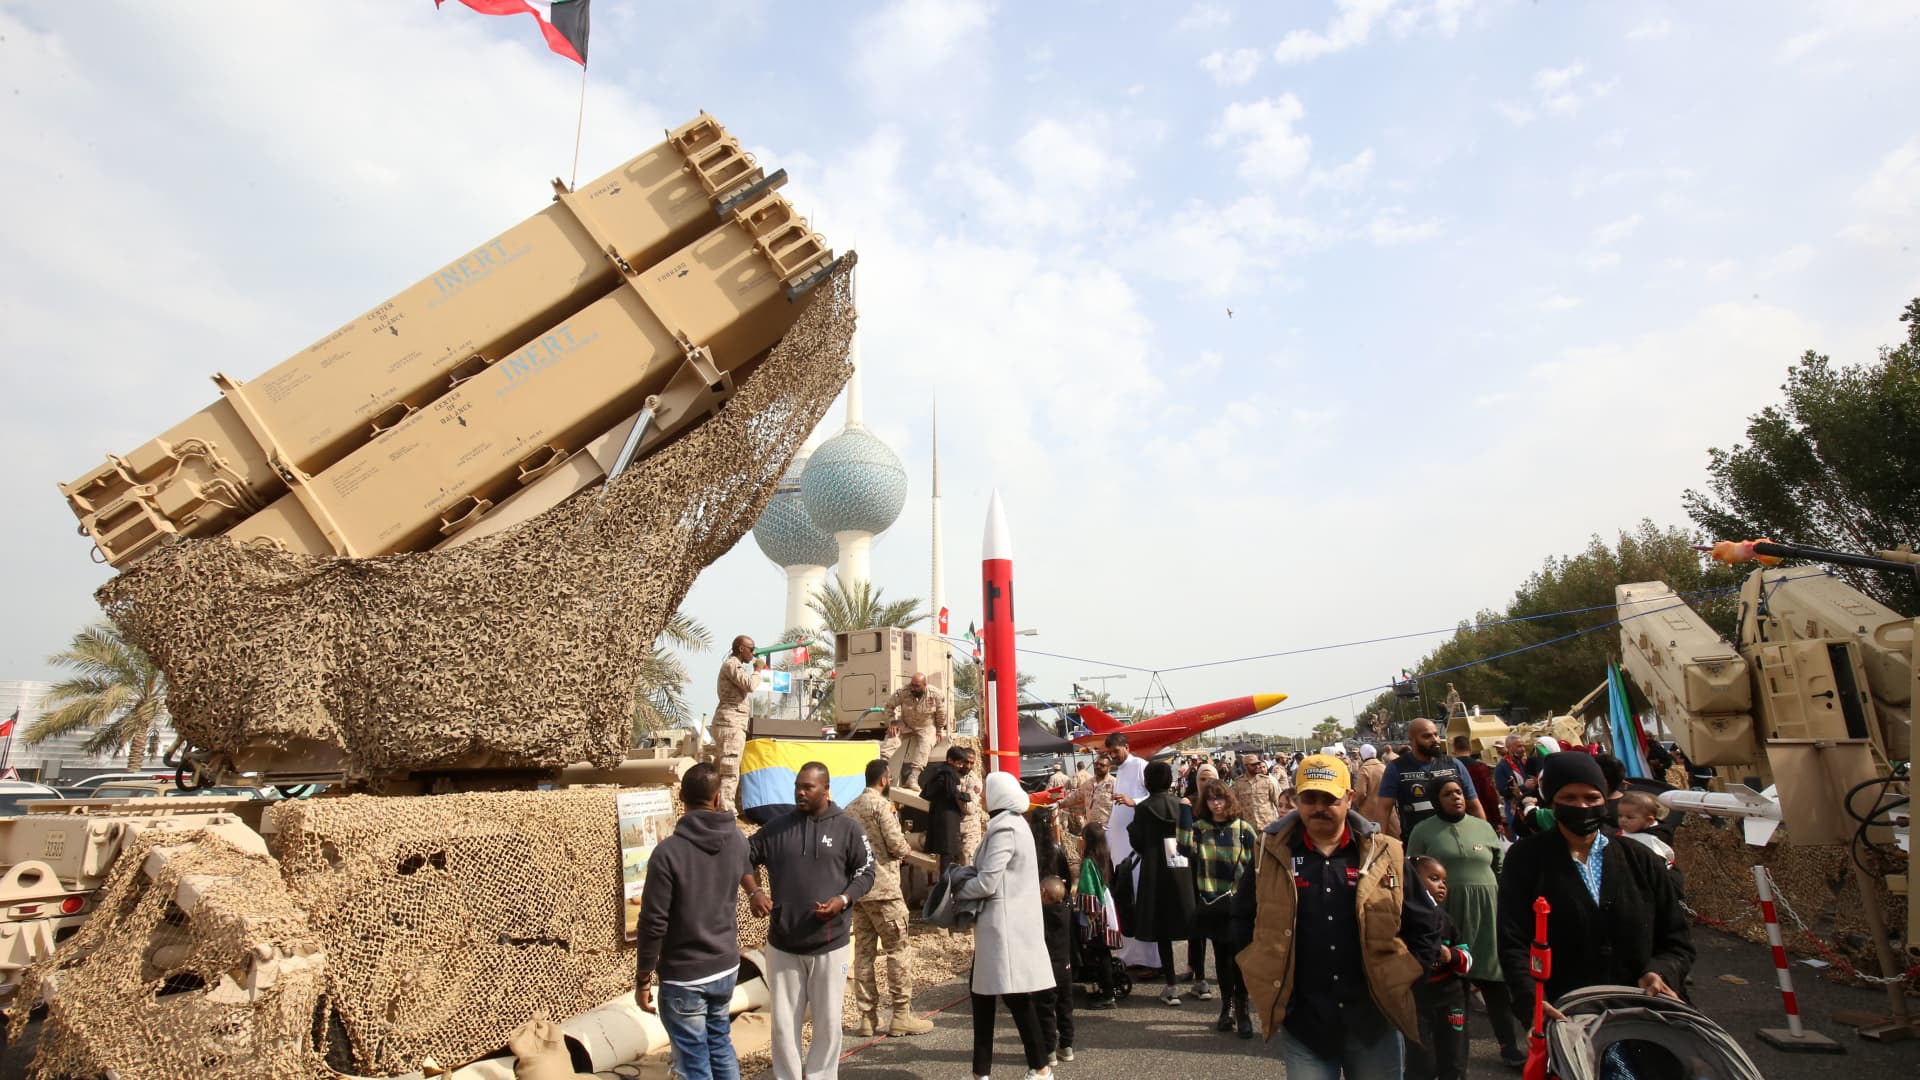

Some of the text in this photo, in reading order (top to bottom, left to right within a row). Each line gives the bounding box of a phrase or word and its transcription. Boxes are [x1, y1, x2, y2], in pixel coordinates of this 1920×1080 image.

[432, 239, 508, 293] INERT
[367, 302, 394, 321] CENTER
[379, 313, 389, 322] OF
[372, 312, 405, 334] BALANCE
[500, 324, 575, 381] INERT
[433, 391, 461, 412] CENTER
[446, 403, 456, 412] OF
[440, 401, 473, 425] BALANCE
[822, 834, 833, 847] AE
